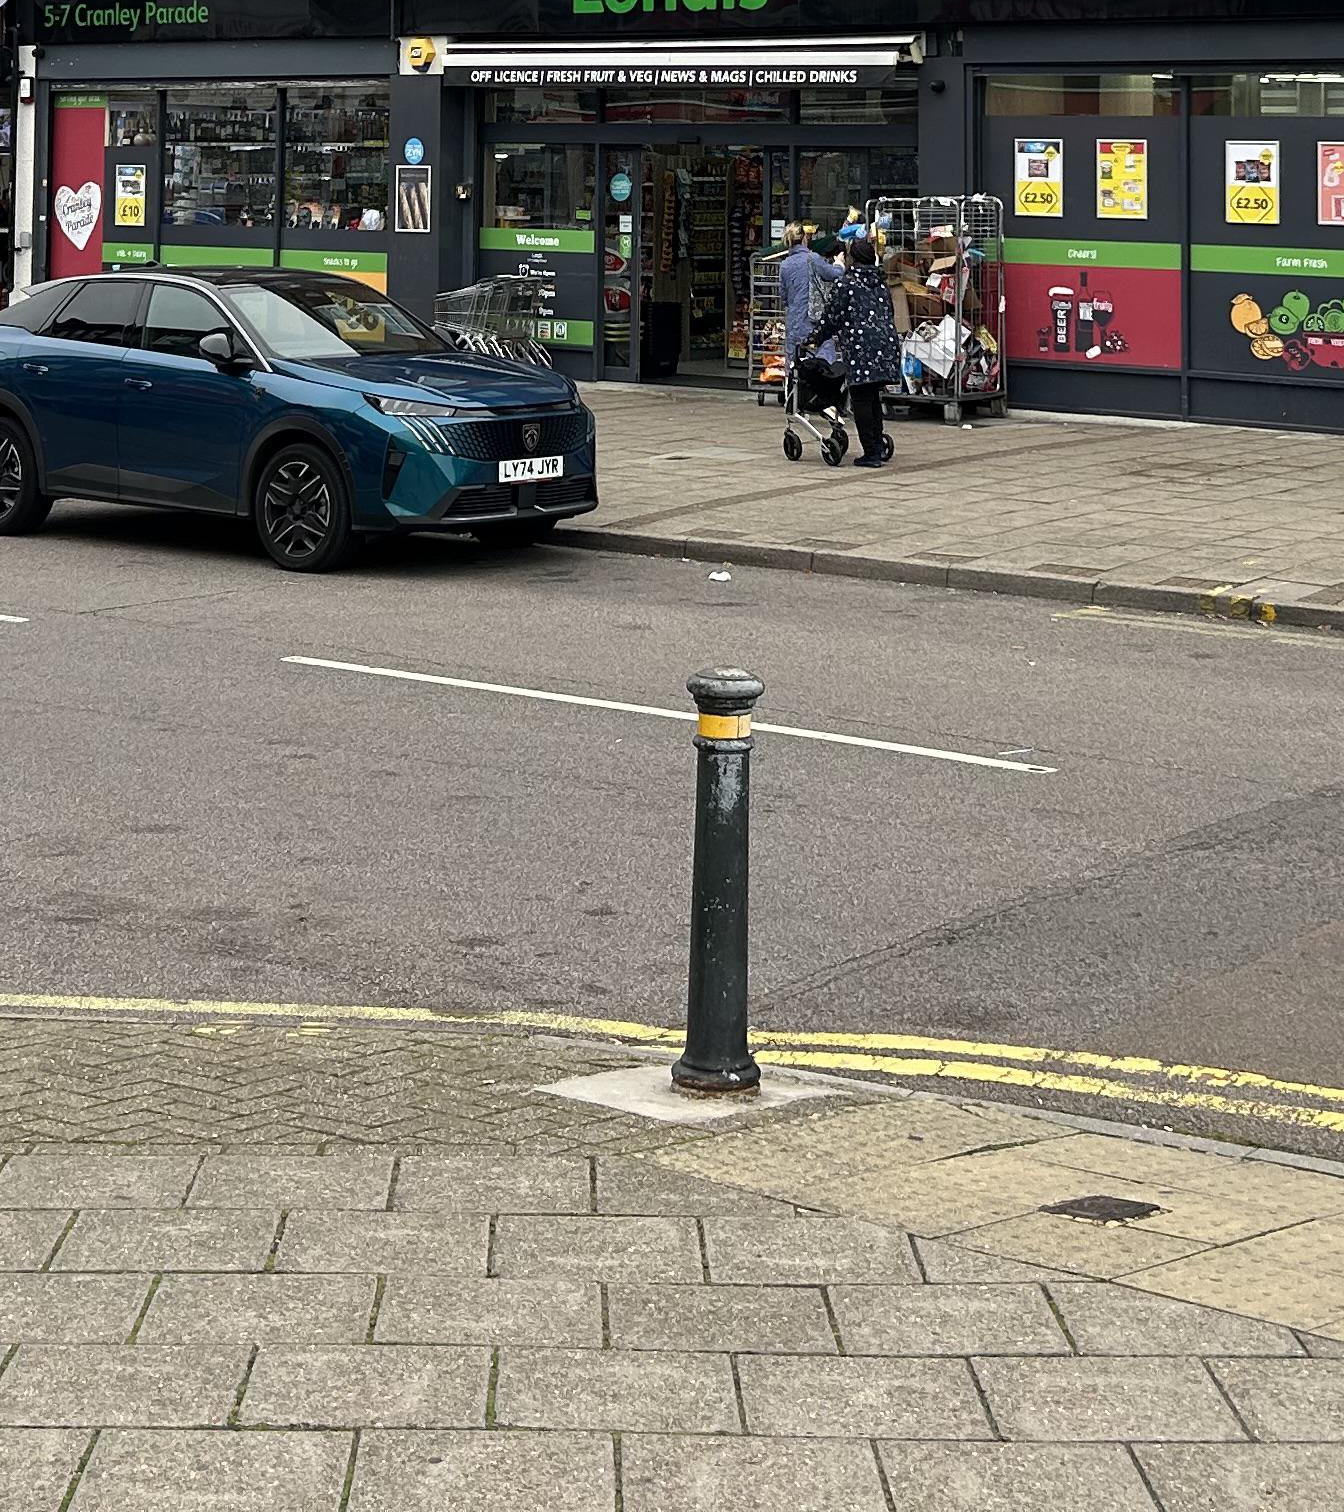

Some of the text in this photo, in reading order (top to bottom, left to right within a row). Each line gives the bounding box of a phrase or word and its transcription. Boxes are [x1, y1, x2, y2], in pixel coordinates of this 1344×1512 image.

[75, 2, 140, 32] Cranley
[145, 0, 209, 24] Parade
[470, 70, 857, 82] OFF LICENCE FRESH FRUIT & VEG NEWS & MAGS CHILLED DRINKS
[1024, 192, 1053, 204] £2.50
[1236, 197, 1268, 209] £2.50
[121, 205, 139, 217] £10
[516, 234, 560, 247] Welcome
[1276, 257, 1328, 268] Farm Fresh
[1057, 309, 1066, 343] BEER
[503, 458, 559, 479] LY74 JYR
